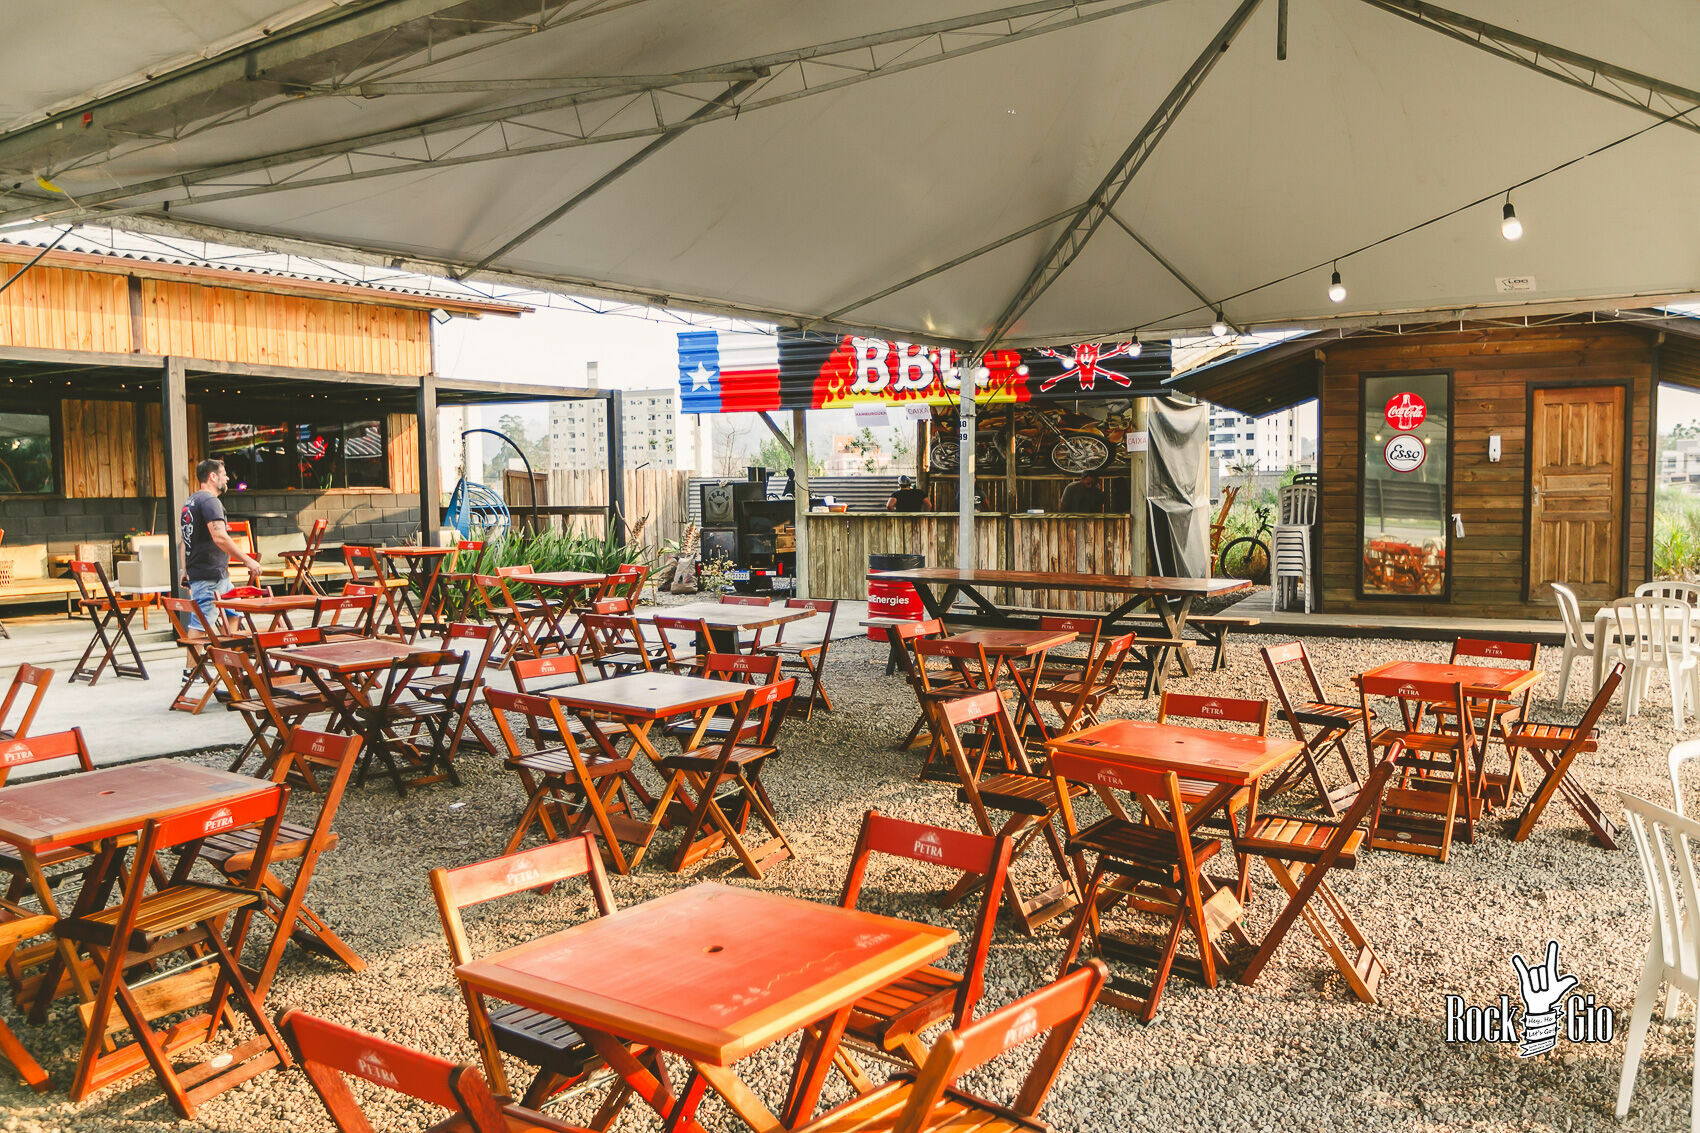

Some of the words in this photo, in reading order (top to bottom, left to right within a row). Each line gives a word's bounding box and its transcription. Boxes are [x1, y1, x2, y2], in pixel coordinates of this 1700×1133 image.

[1390, 444, 1420, 460] Esso
[1398, 688, 1420, 696] PETRA
[1201, 706, 1224, 715] PETRA
[312, 742, 325, 752] PETRA
[4, 750, 34, 762] PETRA
[1097, 772, 1123, 785] PETRA
[204, 816, 234, 831] PETRA
[913, 840, 943, 857] PETRA
[506, 869, 540, 884] PETRA
[358, 1058, 399, 1084] PETRA
